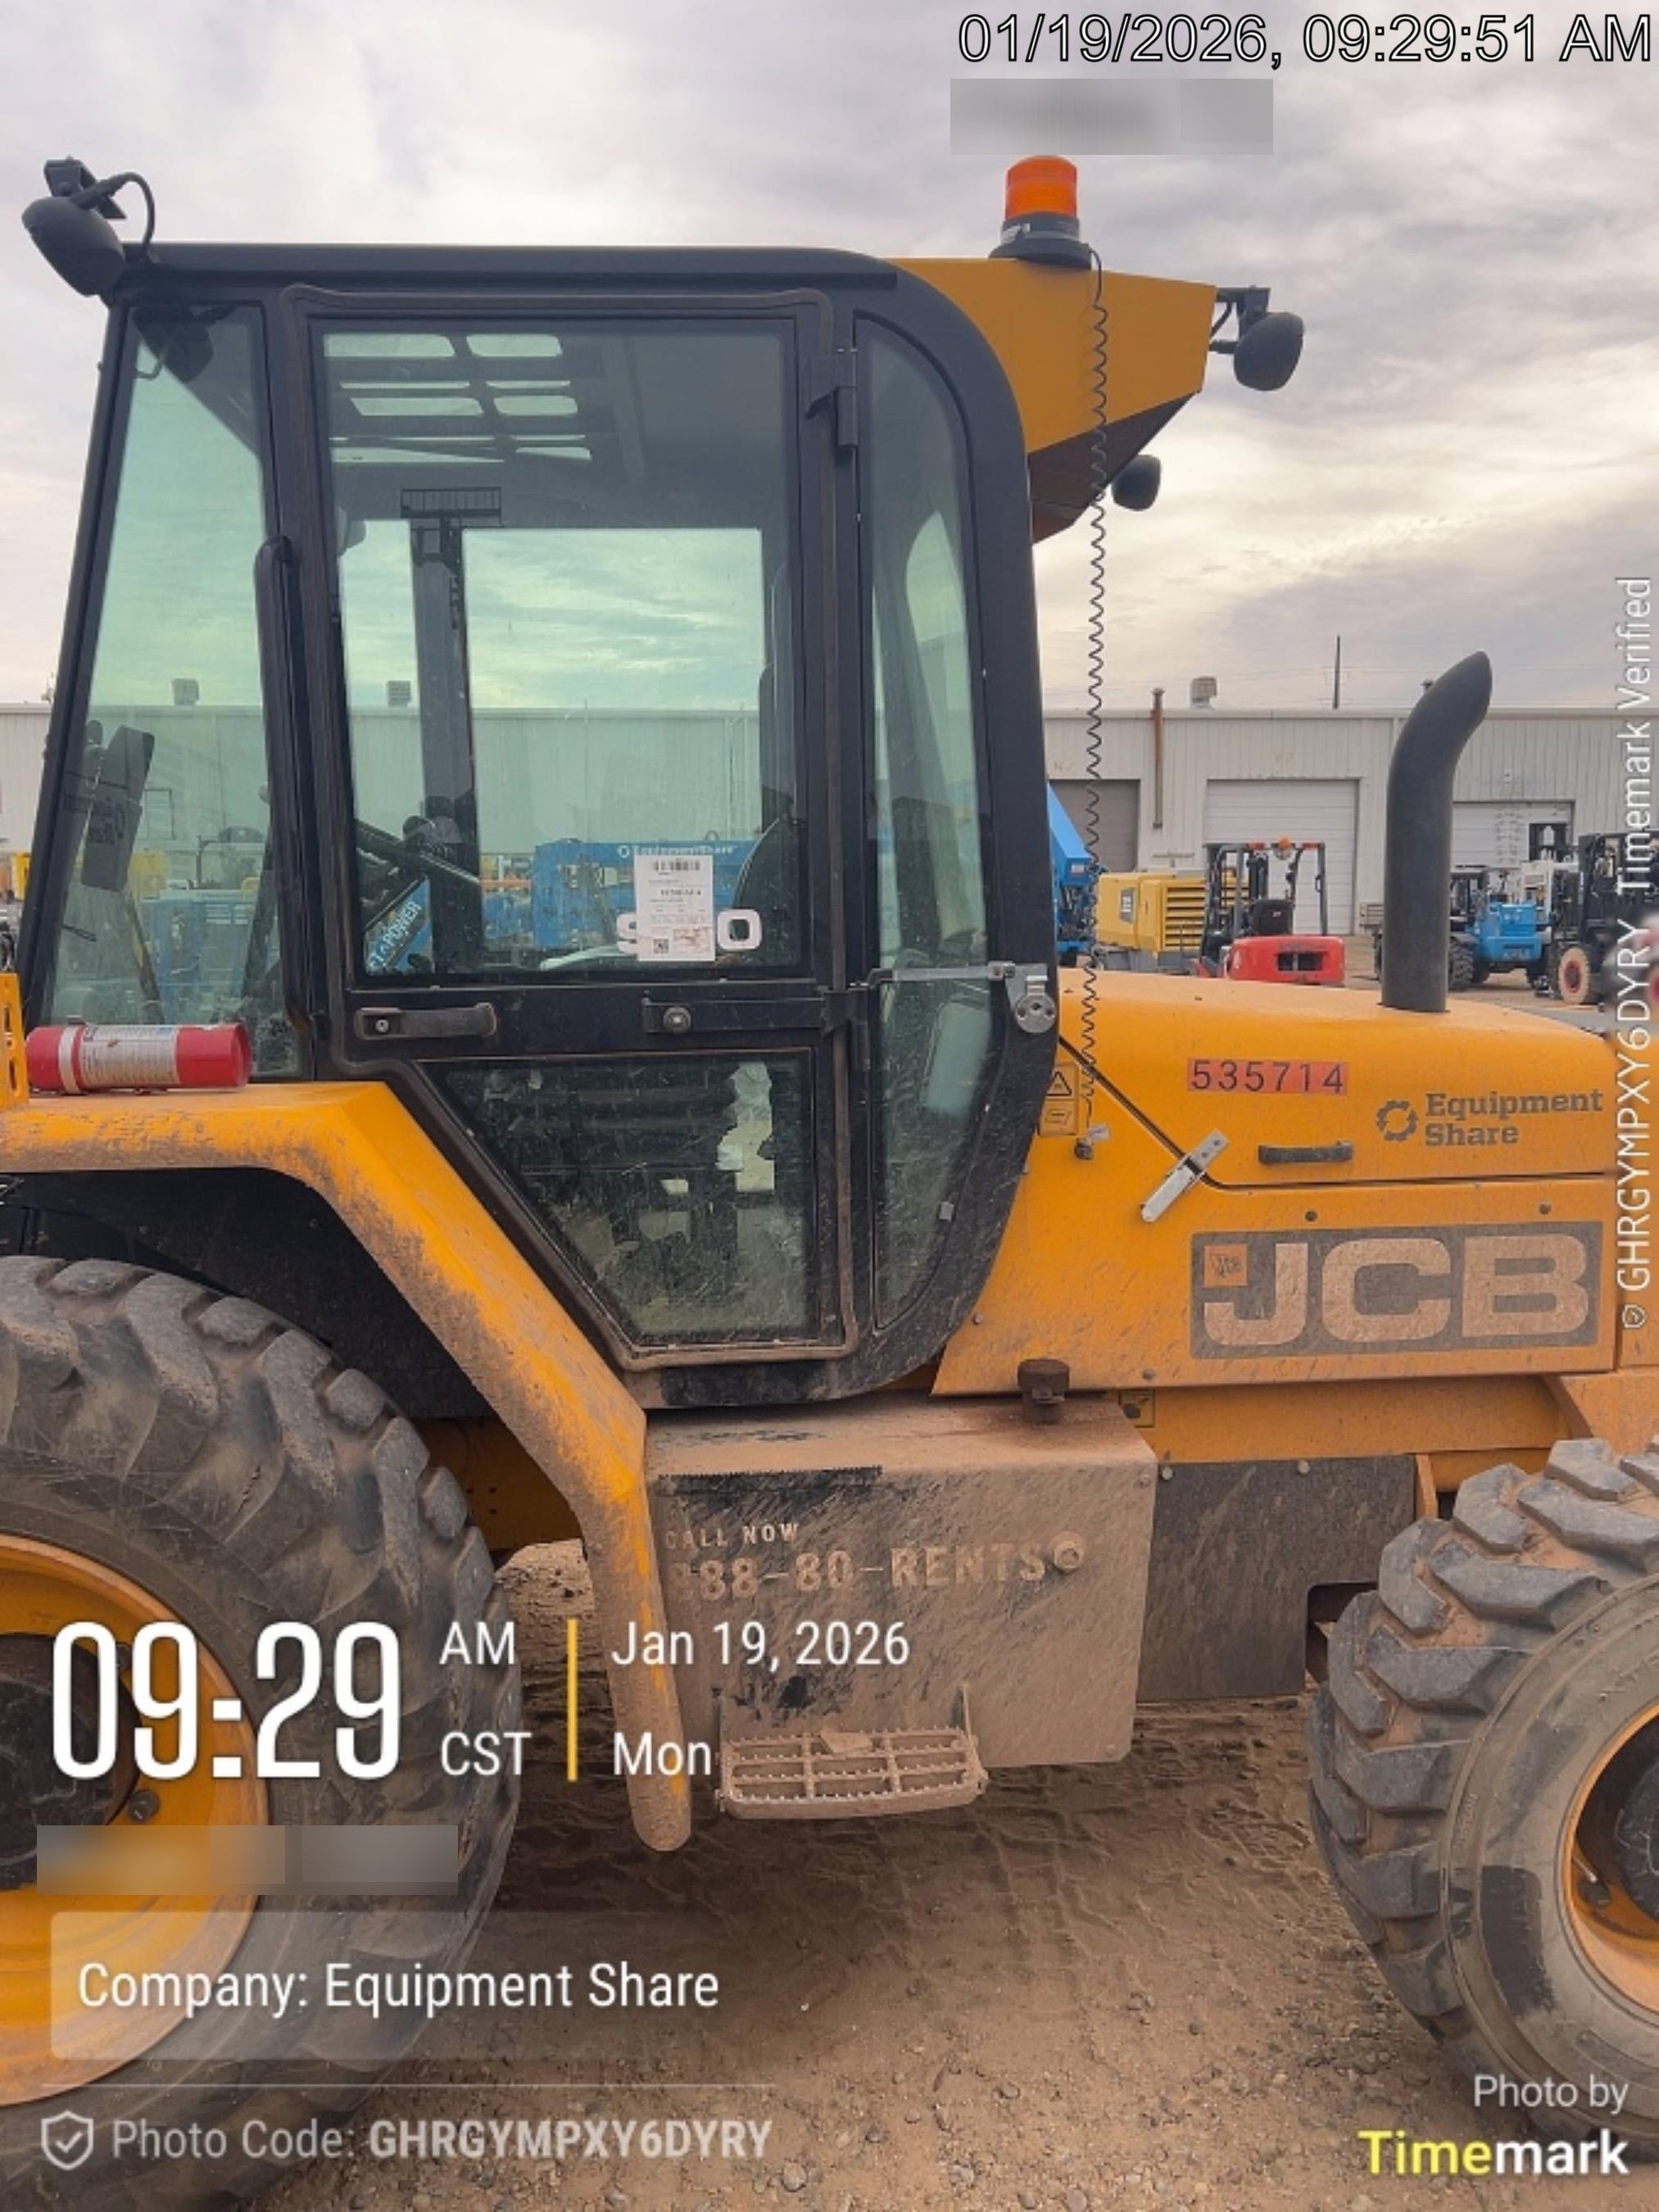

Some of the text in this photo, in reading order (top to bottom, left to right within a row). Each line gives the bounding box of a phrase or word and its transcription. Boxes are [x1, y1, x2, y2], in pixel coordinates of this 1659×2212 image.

[1190, 1059, 1344, 1094] 535714
[1425, 1090, 1603, 1120] Equipment
[1424, 1122, 1520, 1146] Share
[1203, 1233, 1589, 1346] JCB
[664, 1523, 799, 1549] CALL NOW
